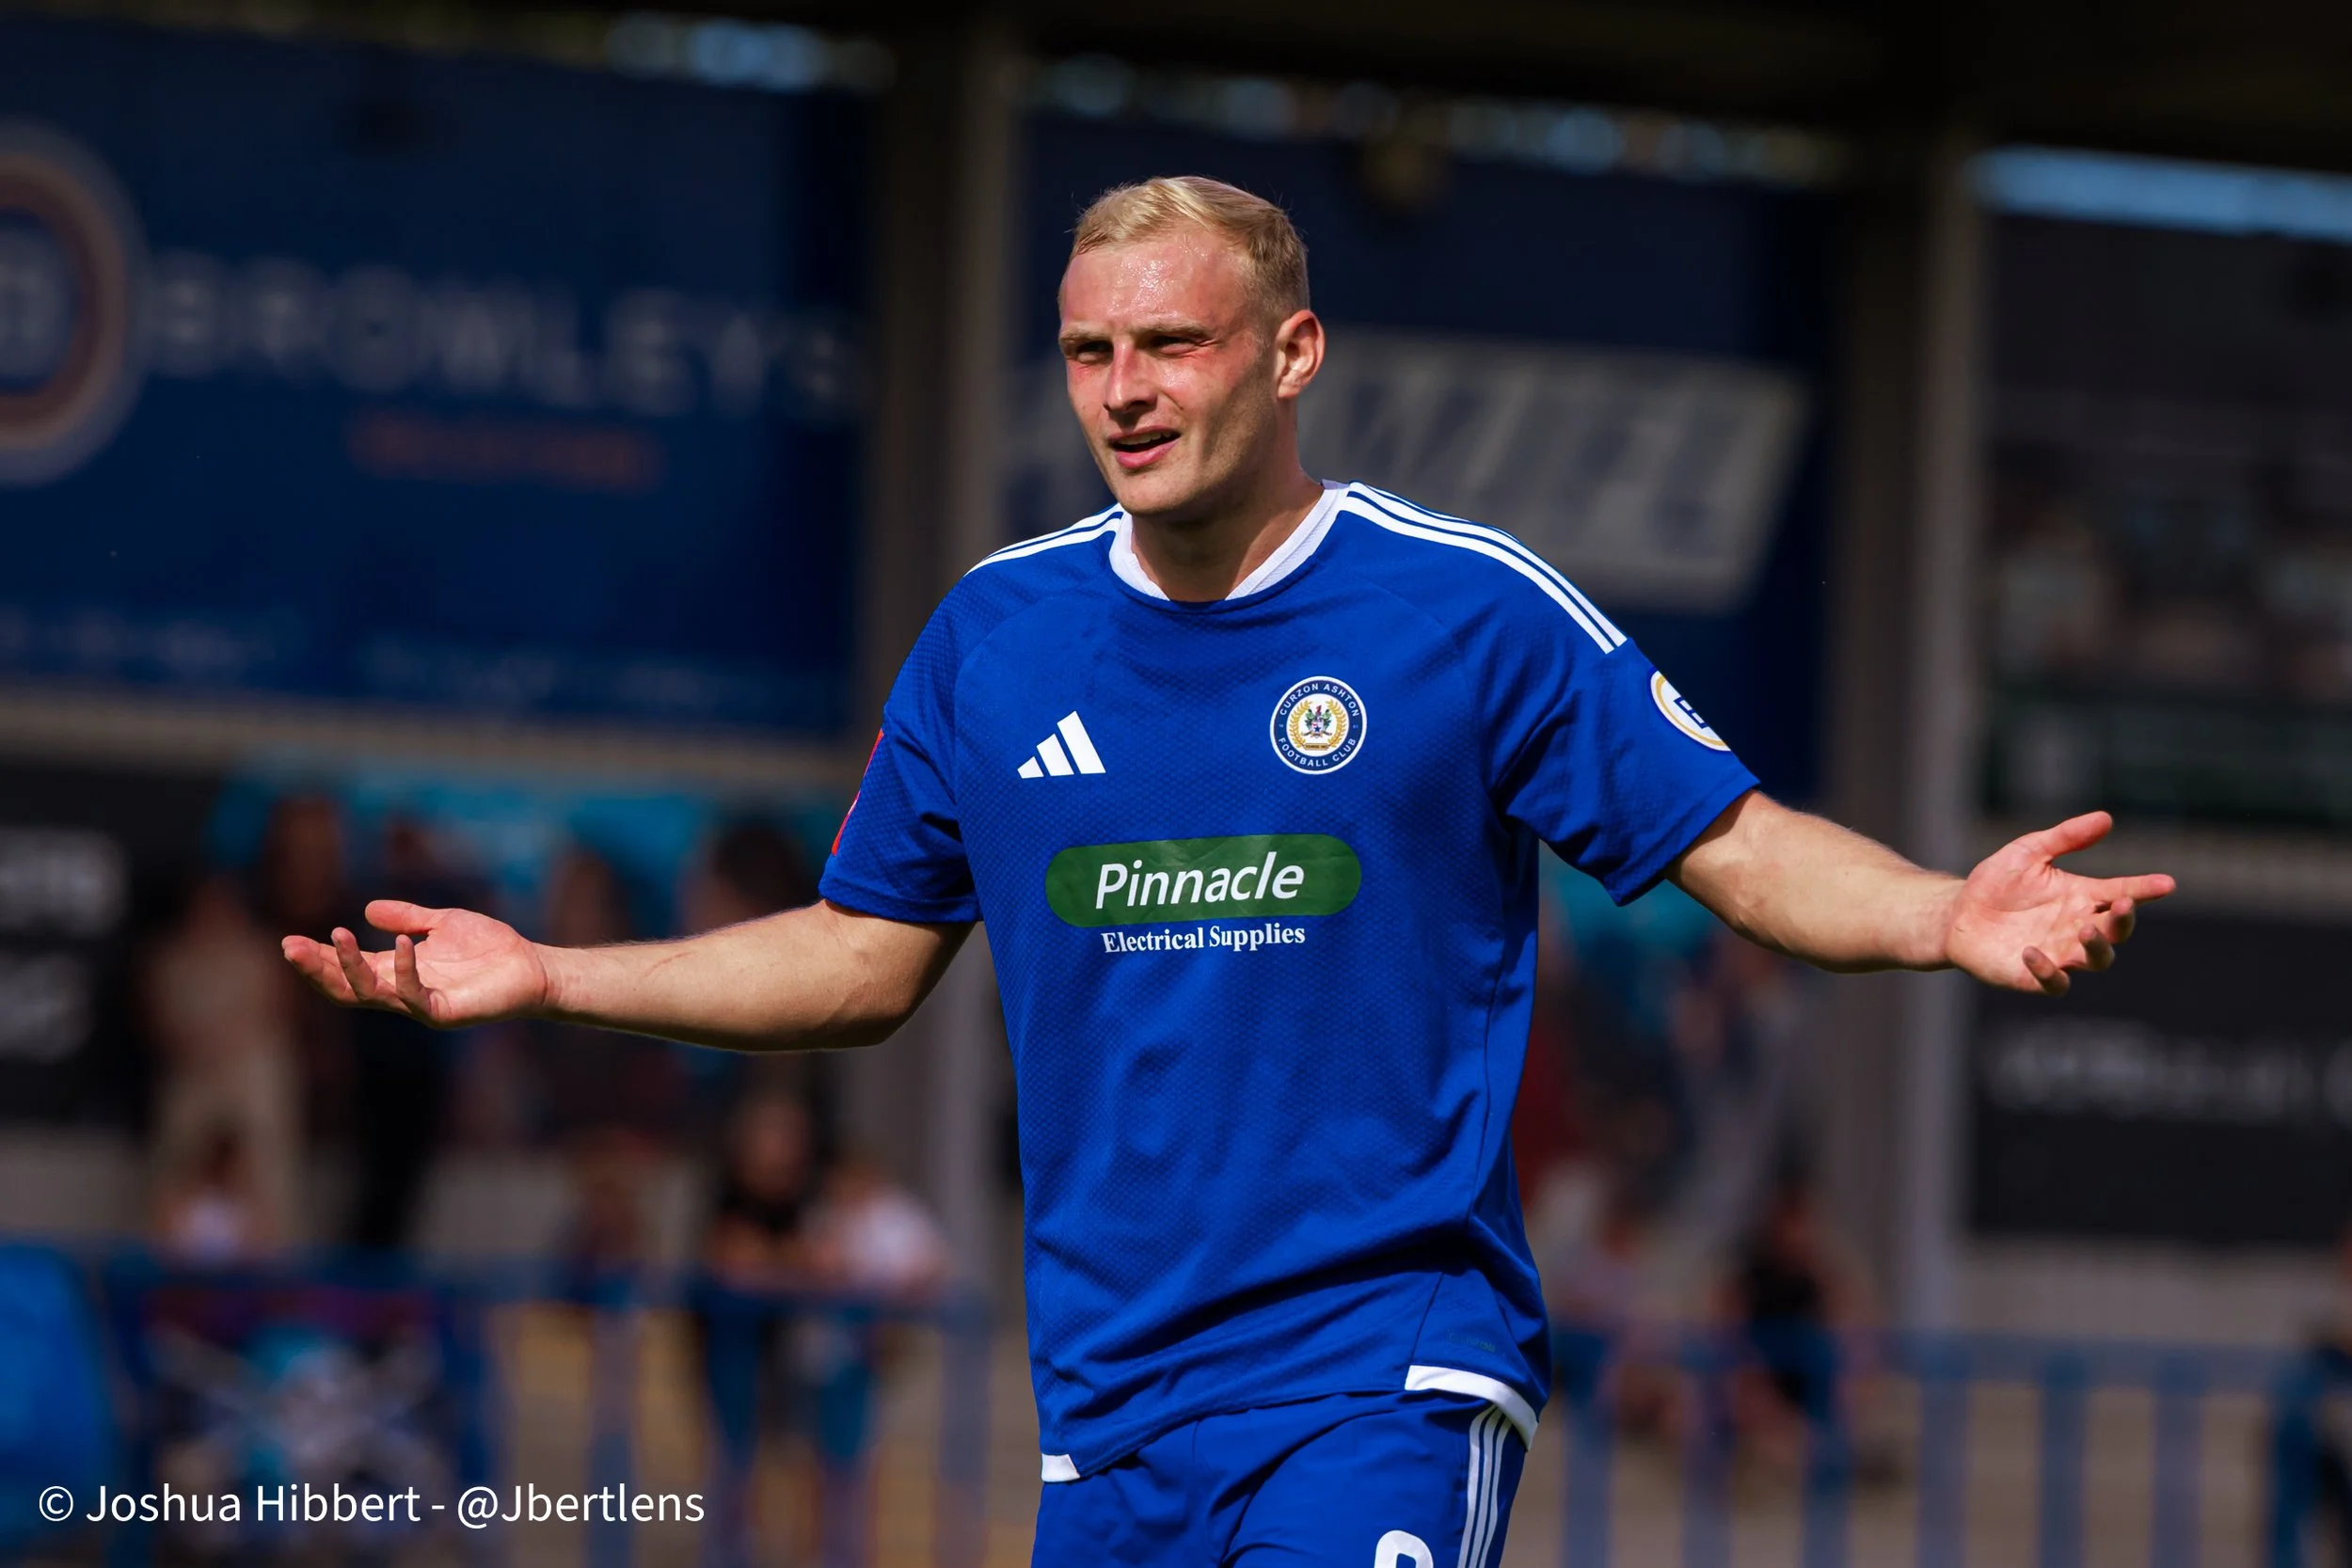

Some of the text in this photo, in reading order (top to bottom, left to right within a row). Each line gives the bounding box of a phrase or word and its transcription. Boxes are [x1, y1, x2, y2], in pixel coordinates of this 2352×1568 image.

[1279, 683, 1360, 717] CURZON ASHTON
[1278, 736, 1356, 768] FOOTBALL CLUB
[1095, 851, 1305, 910] Pinnacle
[1101, 923, 1306, 953] Electrical Supplies
